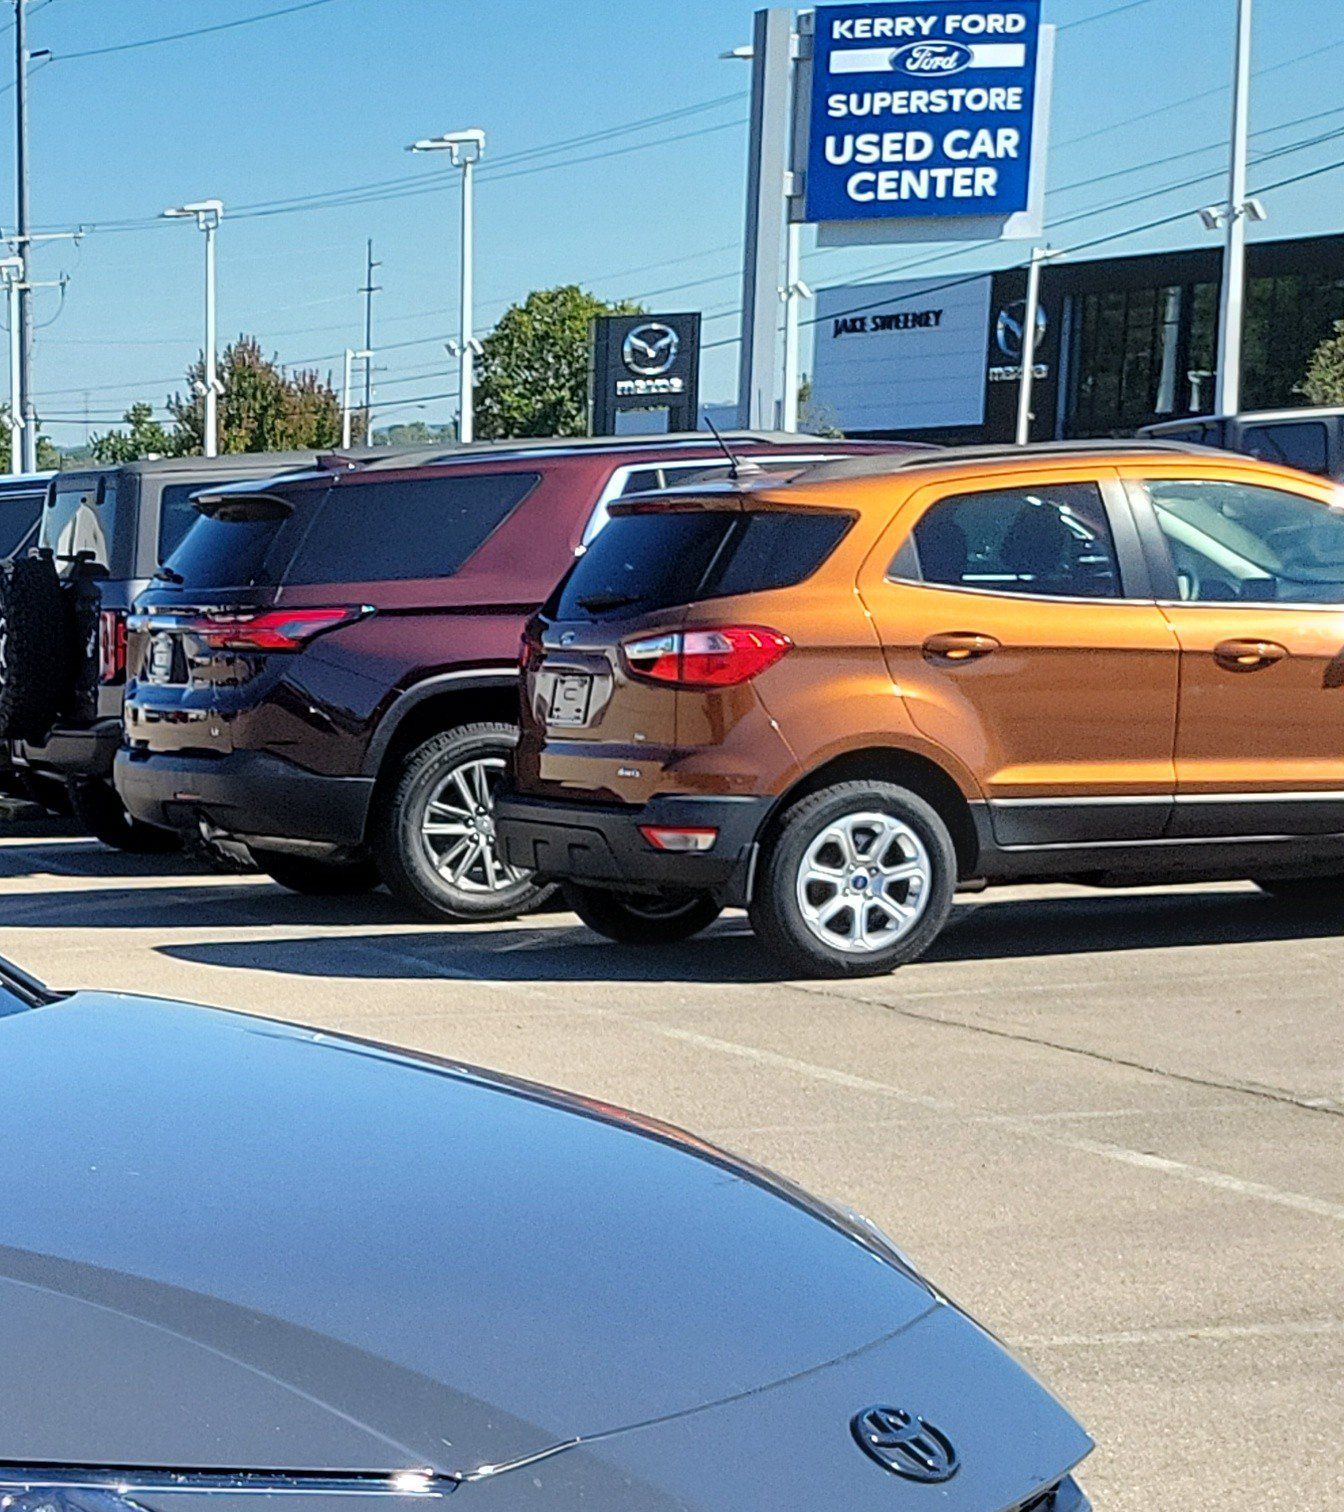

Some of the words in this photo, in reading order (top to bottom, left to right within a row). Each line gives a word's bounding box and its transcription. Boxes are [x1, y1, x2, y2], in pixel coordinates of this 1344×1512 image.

[832, 16, 938, 40] KERRY
[944, 13, 1027, 36] FORD
[905, 45, 960, 71] Ford
[827, 87, 1024, 118] SUPERSTORE
[824, 131, 934, 165] USED
[942, 127, 1021, 161] CAR
[846, 166, 999, 202] CENTER
